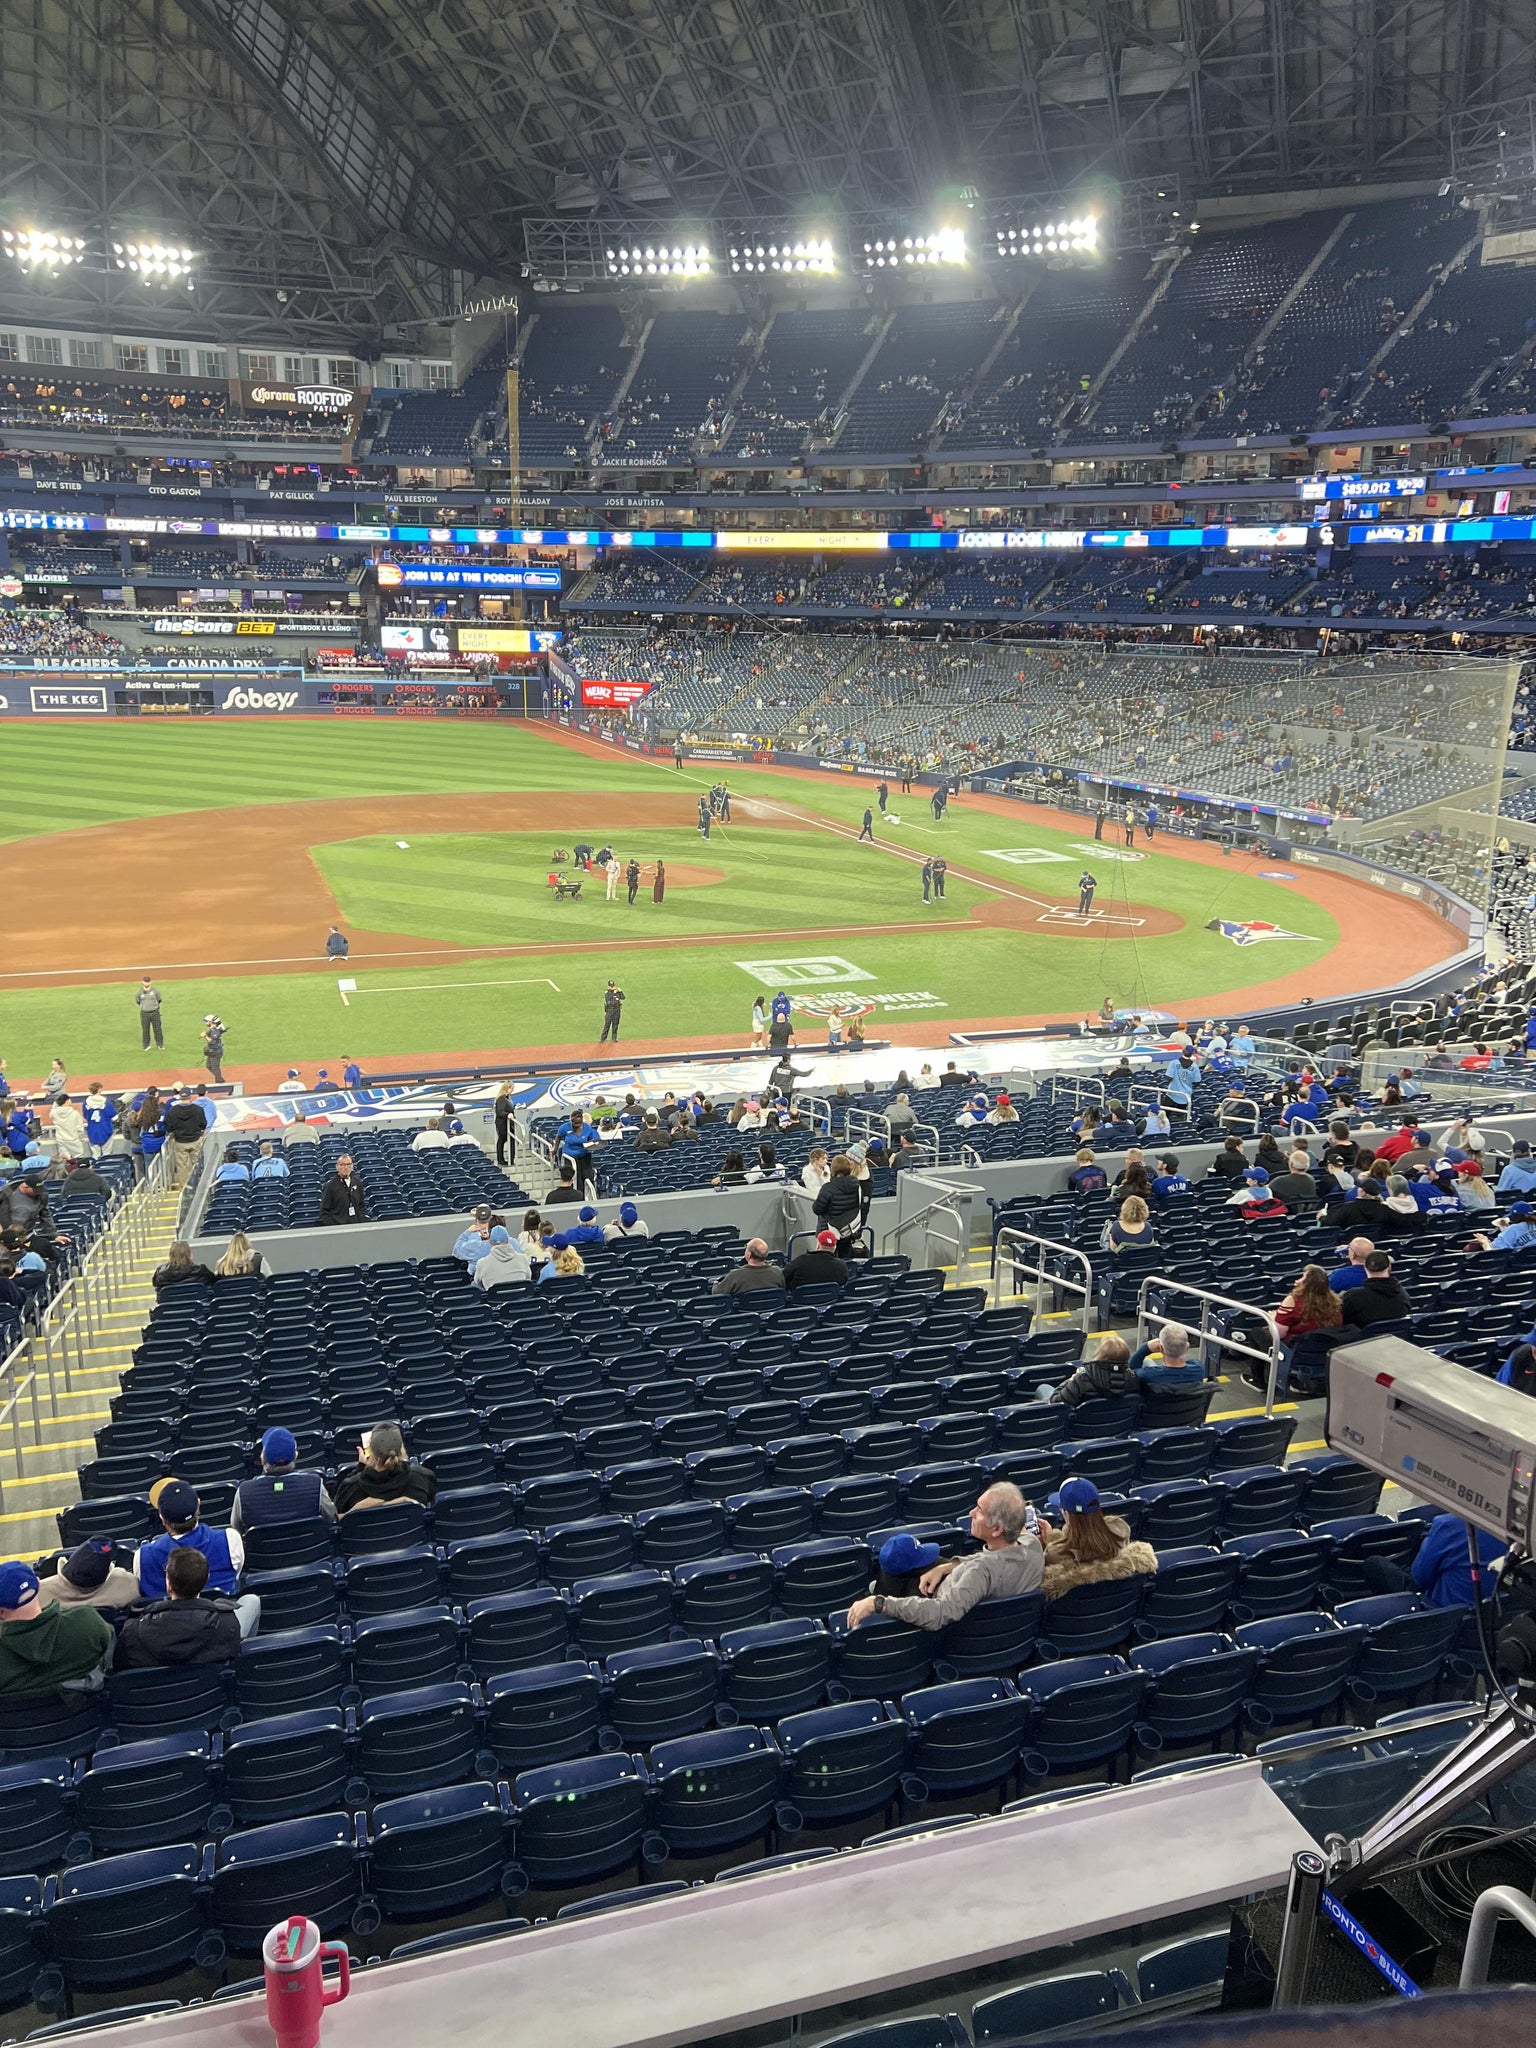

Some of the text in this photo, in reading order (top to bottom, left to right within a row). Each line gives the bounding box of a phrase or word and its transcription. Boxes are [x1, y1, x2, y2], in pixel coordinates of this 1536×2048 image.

[251, 387, 353, 406] Corona ROOFTOP
[313, 405, 338, 413] PATIO
[602, 458, 668, 466] JACKIE ROBINSON
[36, 481, 82, 491] DAVE STIEB
[148, 486, 201, 496] CITO GASTON
[269, 491, 315, 500] PAT GILLICK
[384, 495, 438, 503] PAUL BEESTON
[495, 497, 551, 506] ROY HALLADAY
[604, 497, 665, 507] JOSÉ BAUTISTA
[1365, 525, 1424, 542] MARCH 31
[747, 536, 847, 545] EVERY NIGHT
[24, 574, 69, 582] BLEACHERS
[404, 569, 429, 581] JOIN
[430, 570, 444, 581] US
[446, 571, 460, 582] AT
[461, 572, 482, 583] THE
[483, 573, 523, 584] PORCH!
[154, 619, 233, 634] theScore
[239, 623, 271, 633] BET
[279, 624, 321, 632] SPORTSBOOK
[327, 625, 351, 633] CASINO
[462, 632, 488, 640] EVERY
[462, 640, 489, 648] NIGHT
[166, 658, 228, 669] CANADA
[125, 682, 151, 690] Active
[342, 684, 374, 692] ROGERS
[404, 685, 436, 693] ROGERS
[466, 686, 497, 694] ROGERS
[507, 682, 521, 690] 328
[584, 685, 612, 699] HEINZ
[40, 695, 99, 705] THE KEG
[222, 686, 299, 711] Sobeys
[343, 706, 375, 714] ROGERS
[405, 707, 437, 716] ROGERS
[857, 766, 885, 776] BASELINE
[787, 991, 942, 1010] PENING WEEK
[883, 1001, 949, 1011] Adobe
[90, 1109, 101, 1123] 4
[1378, 1955, 1407, 1991] BLUE
